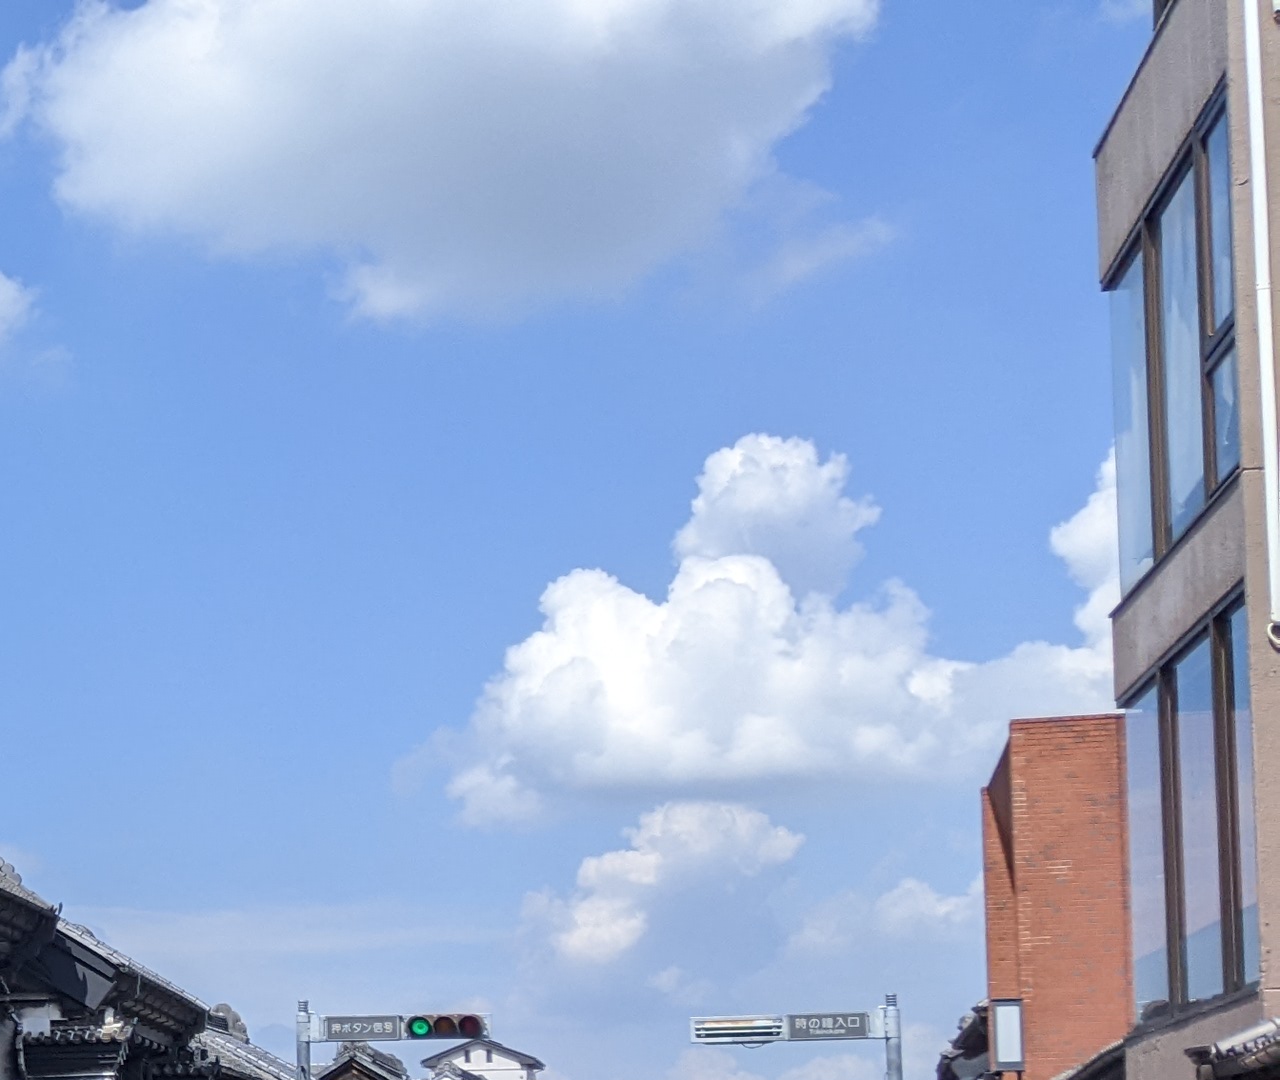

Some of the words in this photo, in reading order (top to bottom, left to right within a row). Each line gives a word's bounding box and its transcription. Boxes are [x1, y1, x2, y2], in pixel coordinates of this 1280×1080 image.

[331, 1021, 394, 1034] 押ボタン信号
